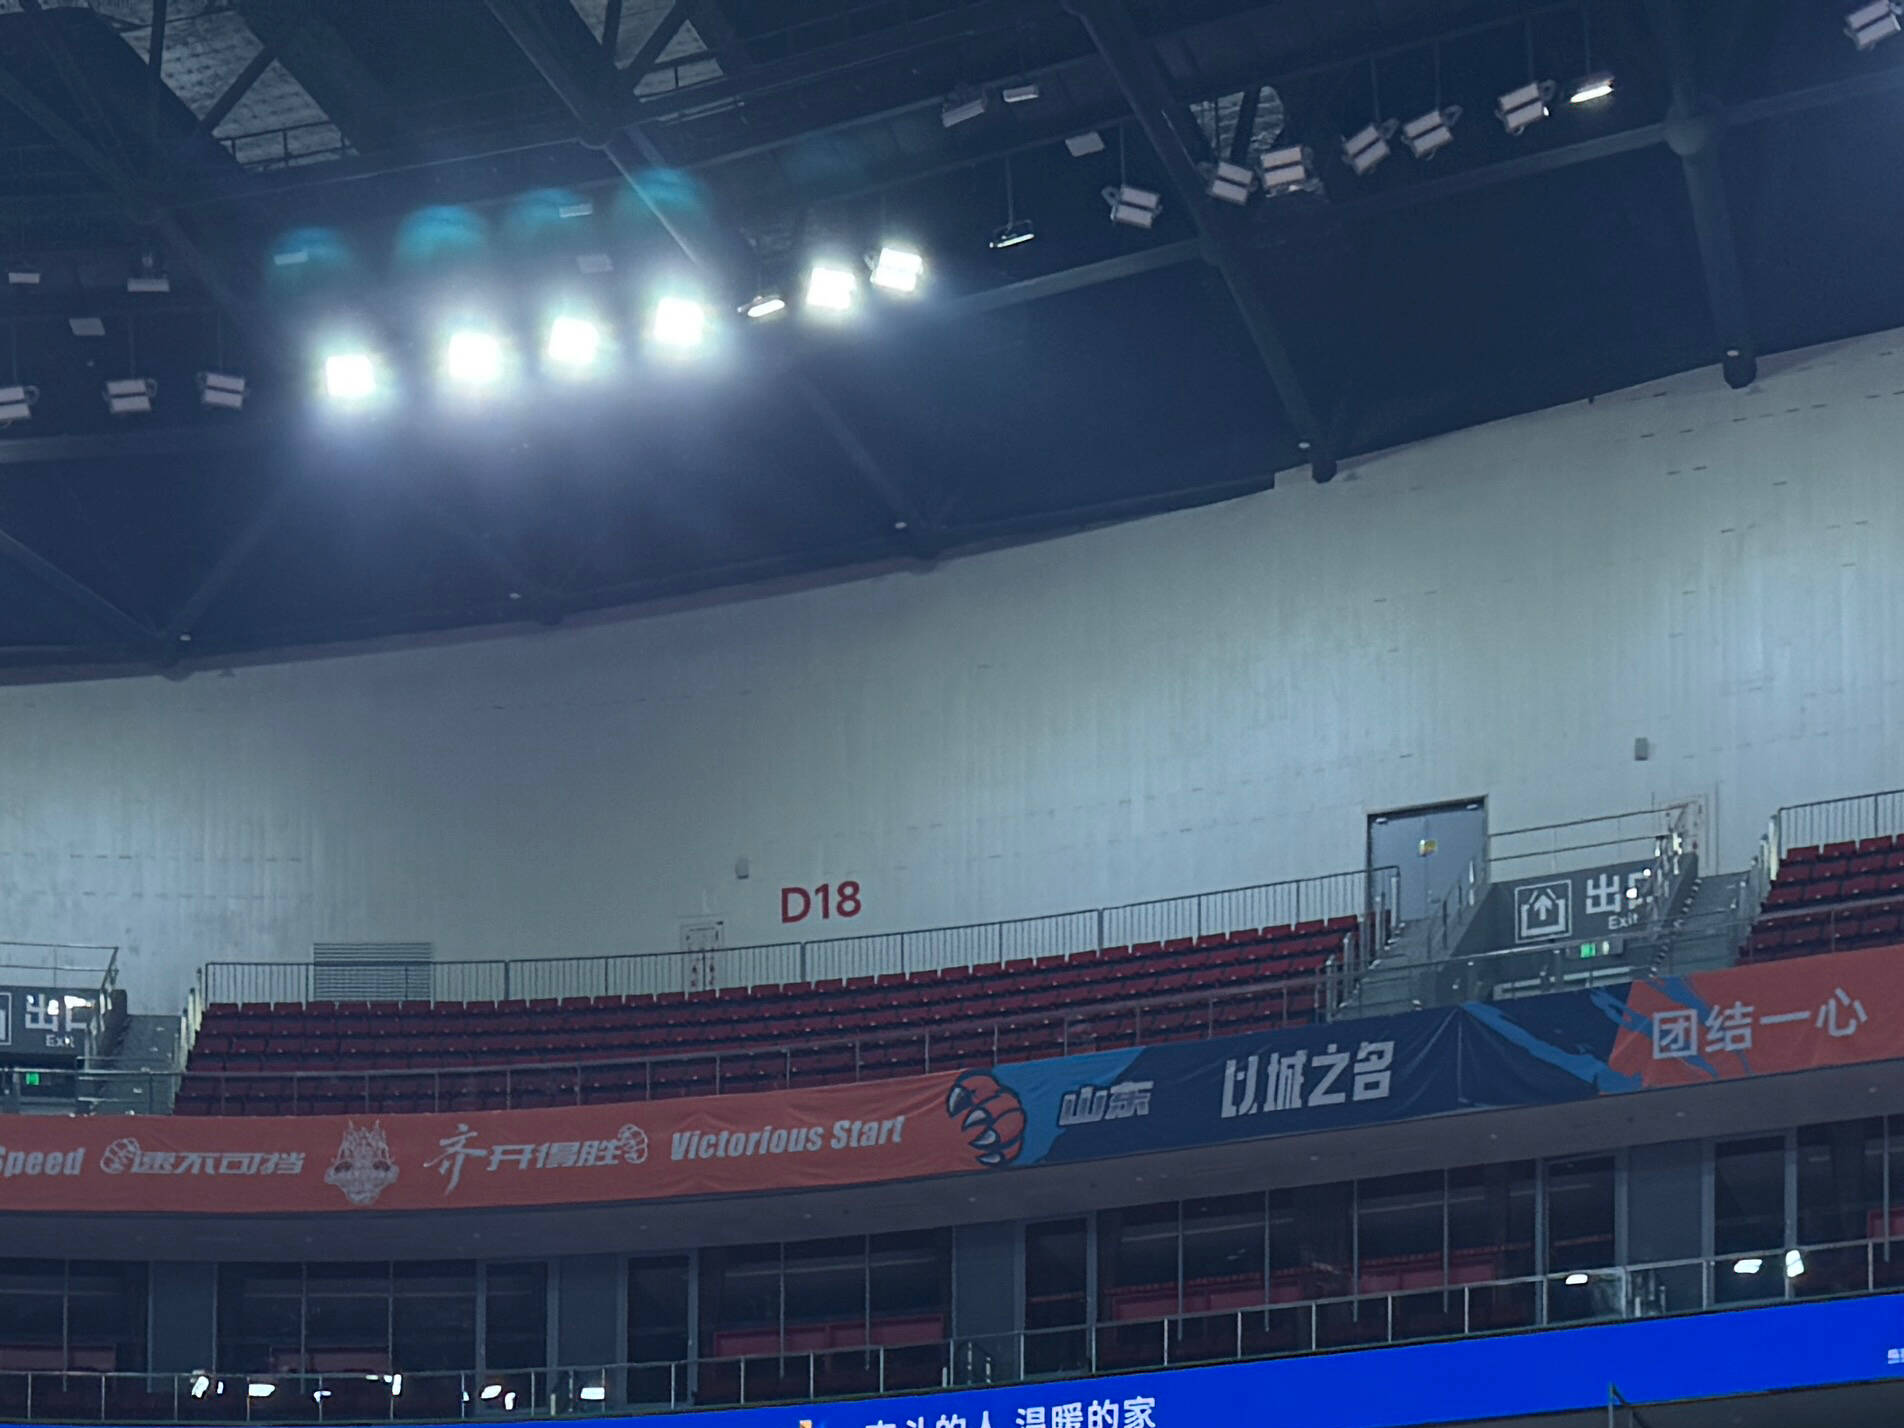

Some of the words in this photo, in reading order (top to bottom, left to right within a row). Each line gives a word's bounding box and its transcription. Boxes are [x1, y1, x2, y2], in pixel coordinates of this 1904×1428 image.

[780, 881, 863, 923] D18
[1608, 913, 1638, 930] Exit
[25, 994, 95, 1032] 出口
[1651, 985, 1868, 1061] 团结一心
[1221, 1040, 1395, 1118] 以城之名
[1058, 1079, 1154, 1127] 山东
[670, 1126, 823, 1160] Victorious
[831, 1116, 906, 1150] Start
